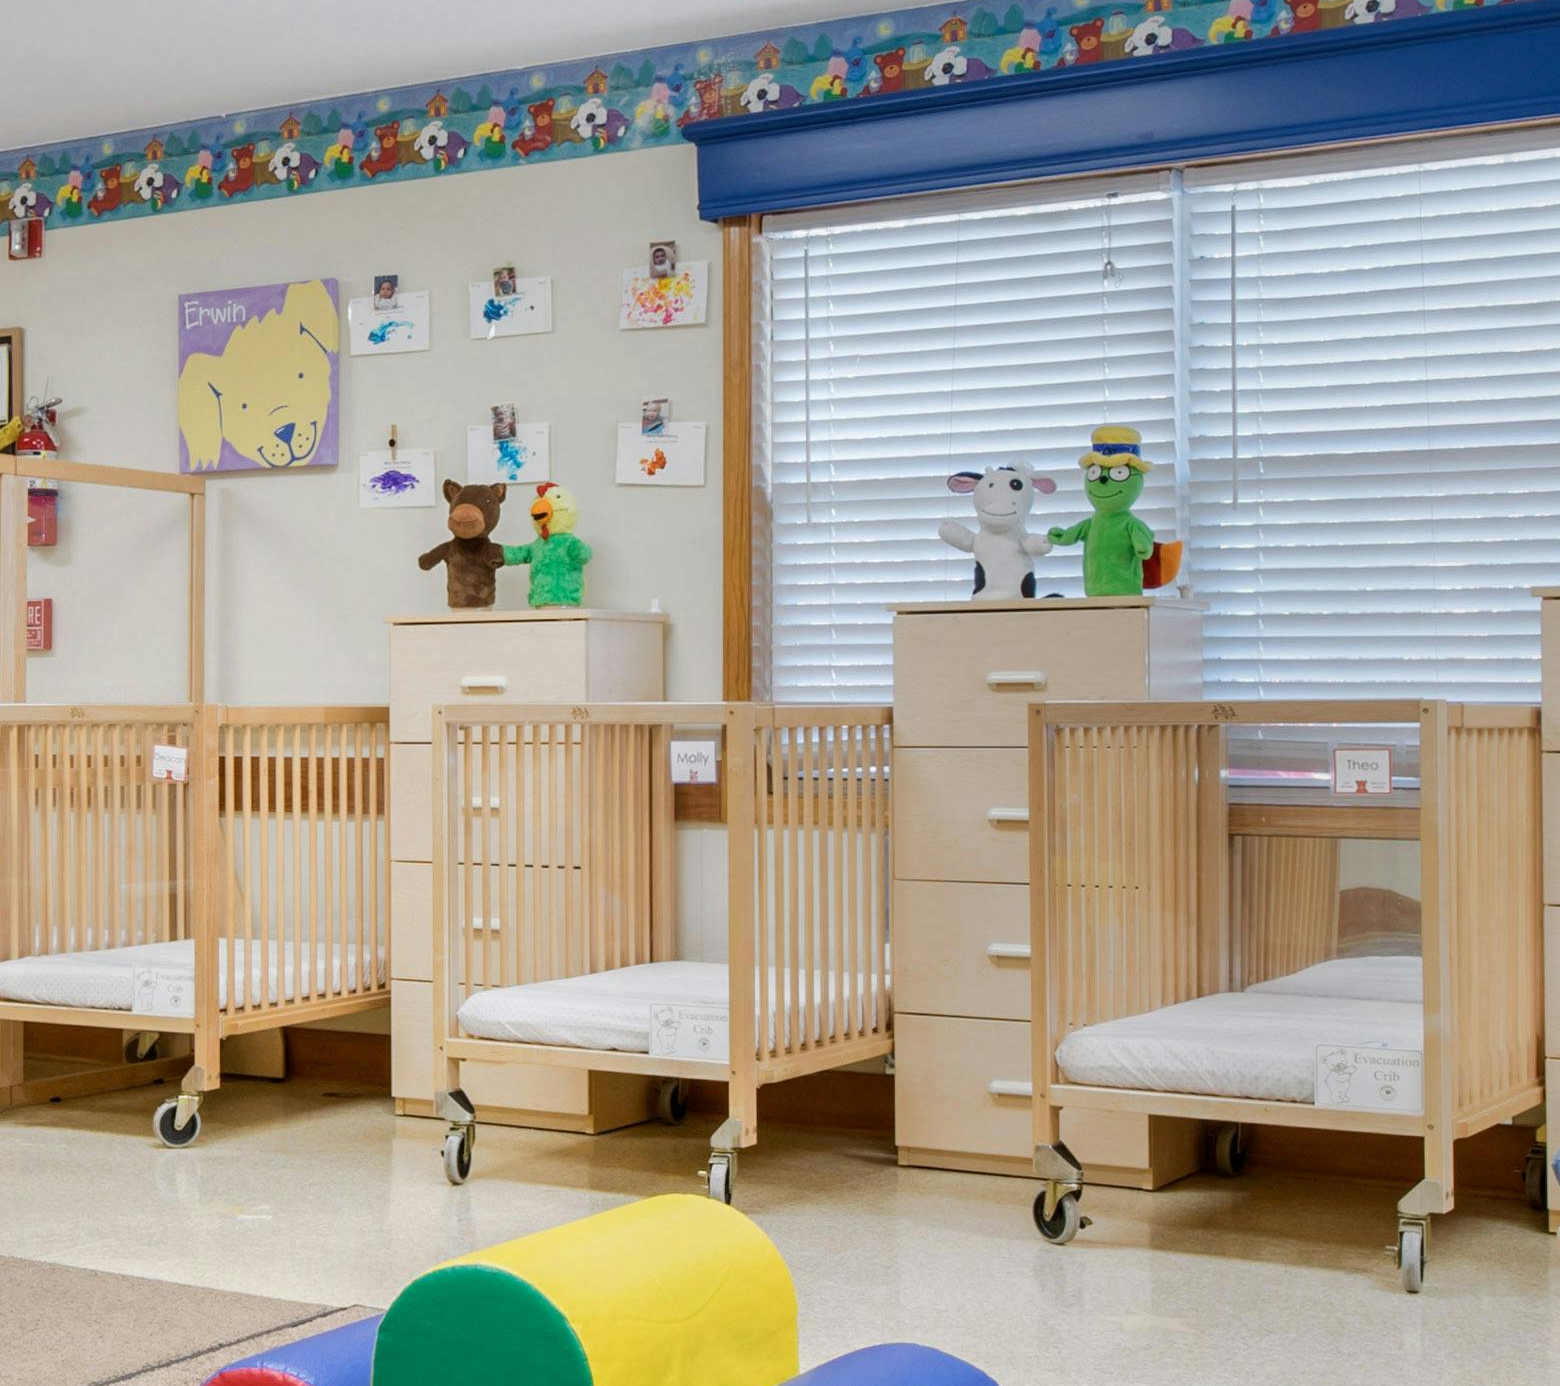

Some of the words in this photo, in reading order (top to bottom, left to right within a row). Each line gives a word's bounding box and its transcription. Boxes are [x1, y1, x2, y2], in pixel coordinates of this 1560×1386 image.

[184, 300, 246, 329] Erwin
[677, 753, 709, 766] Molly
[1346, 759, 1379, 771] Theo
[1354, 1053, 1420, 1068] Evacuation
[1374, 1070, 1400, 1082] Crib
